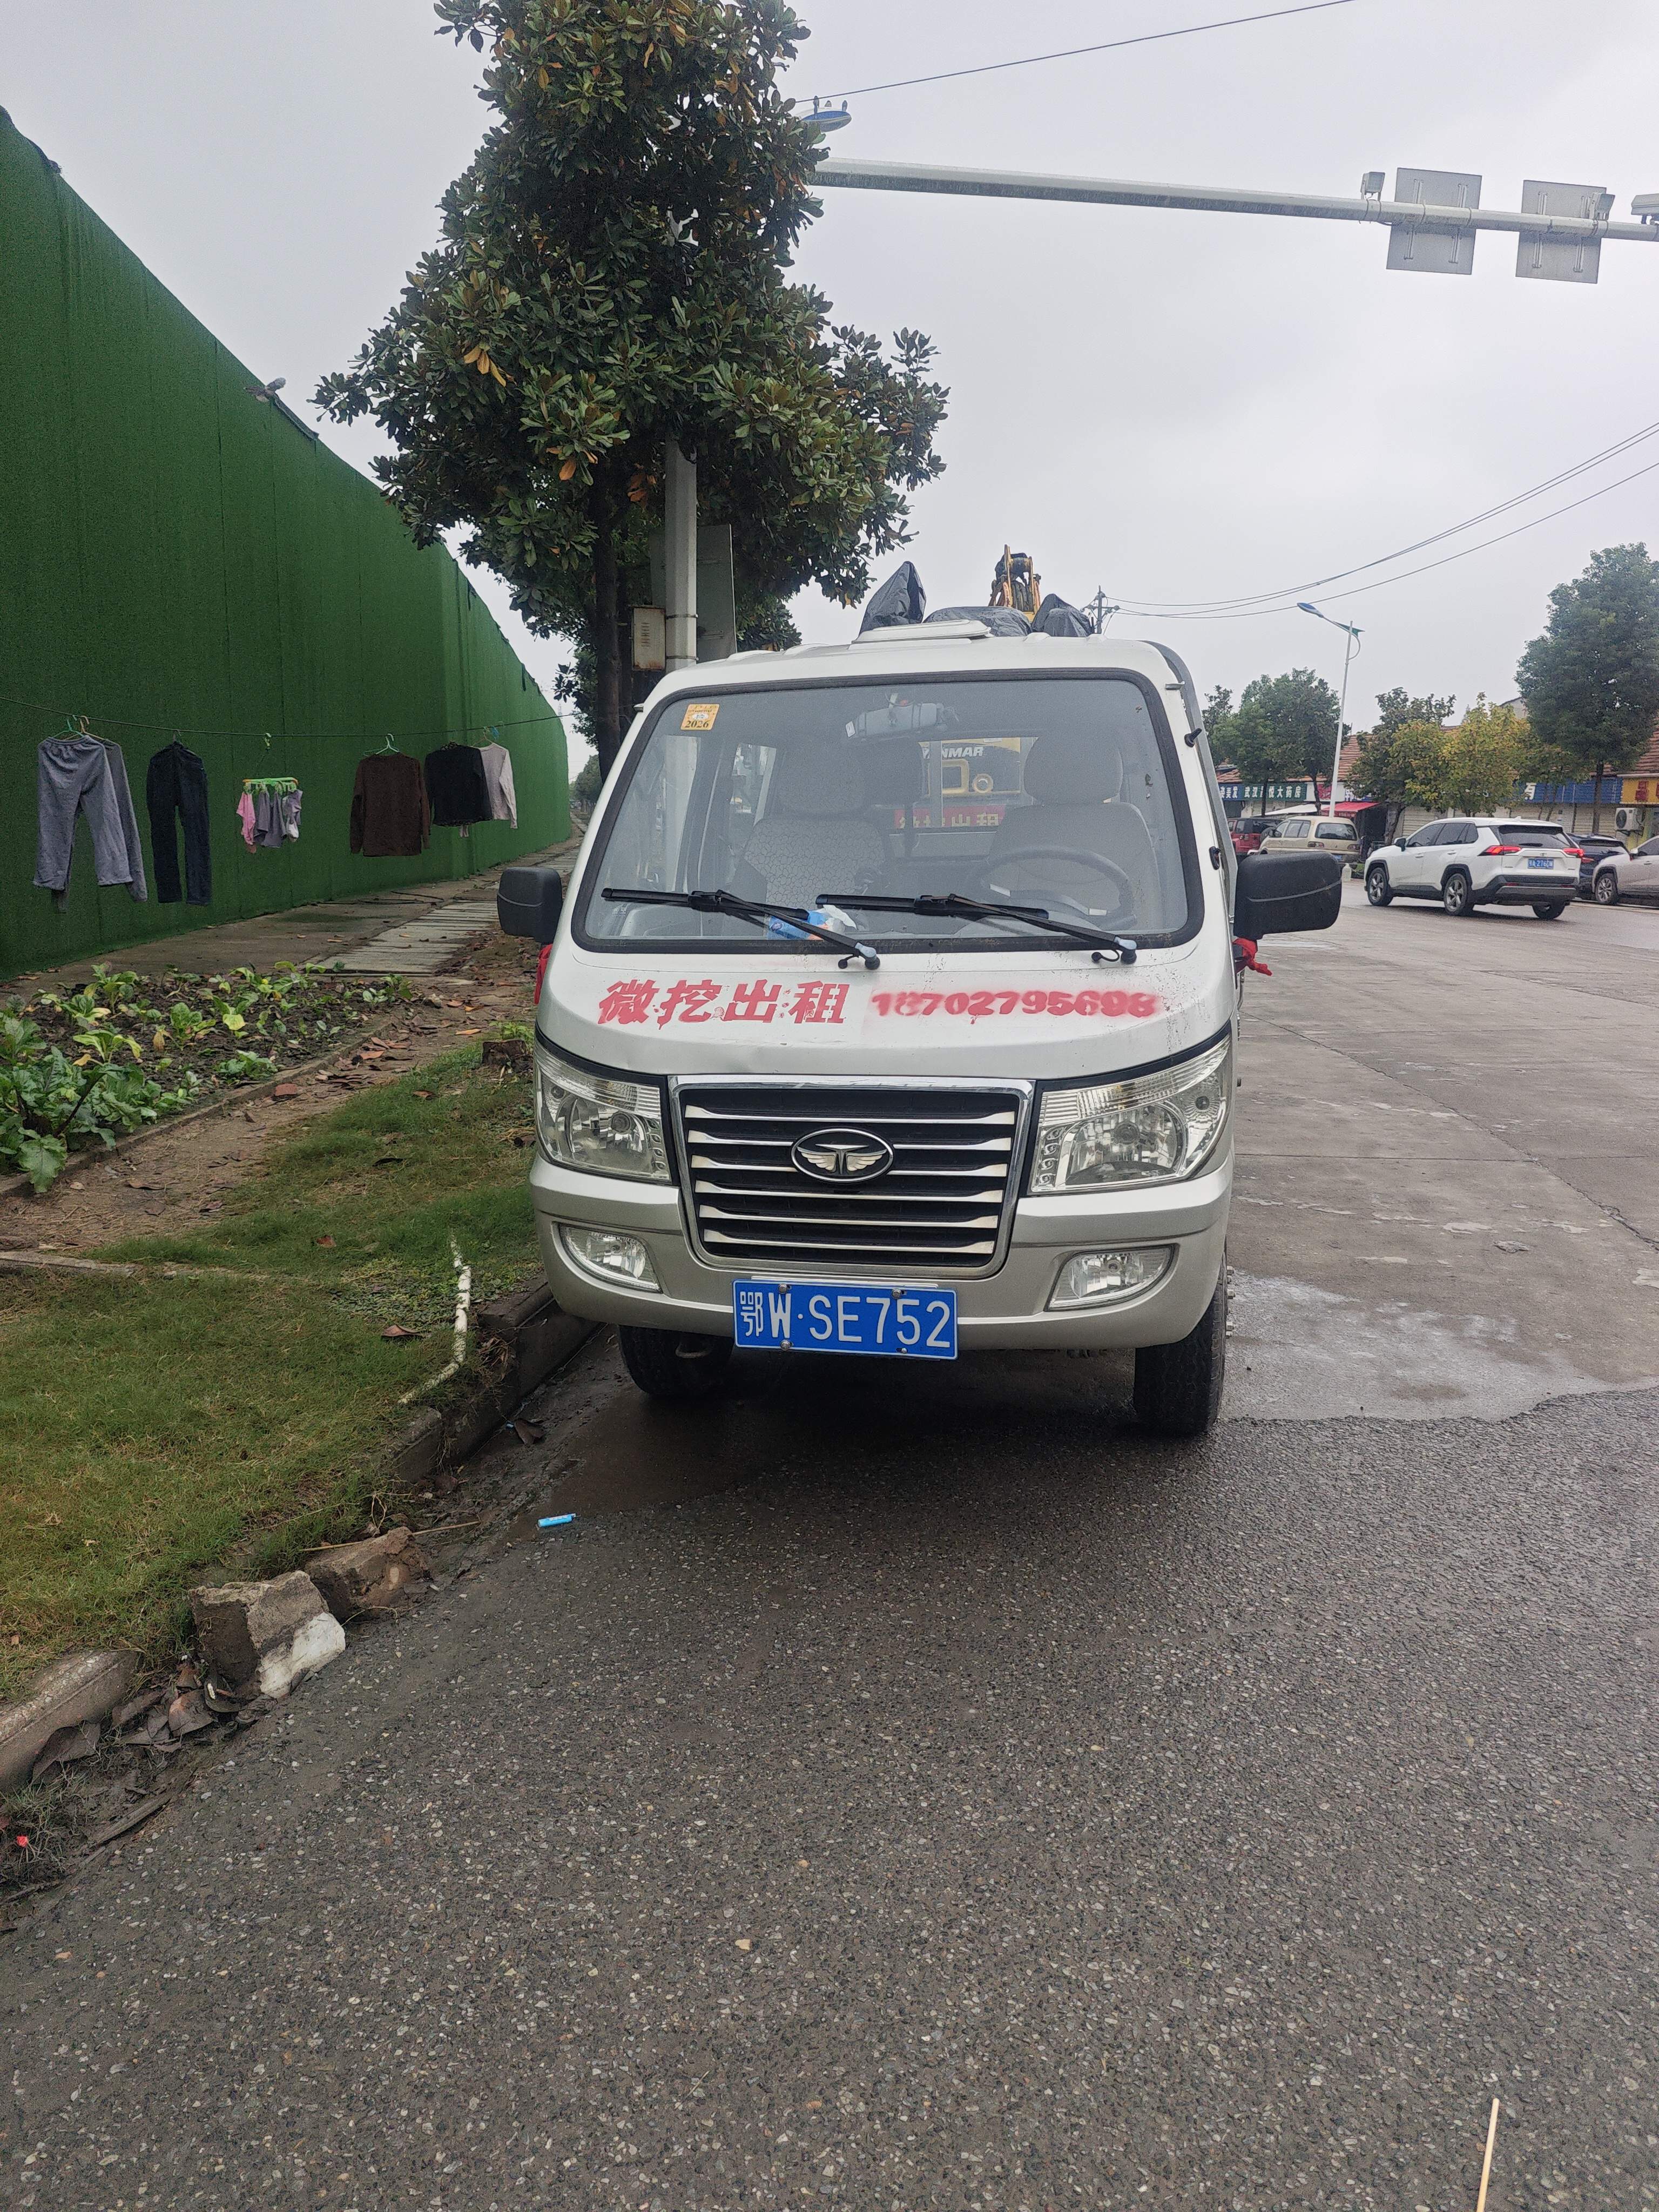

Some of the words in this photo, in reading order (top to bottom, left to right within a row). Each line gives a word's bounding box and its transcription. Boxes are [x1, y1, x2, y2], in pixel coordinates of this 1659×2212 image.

[597, 979, 851, 1025] 微挖出租
[740, 1291, 950, 1348] 鄂W·SE752
